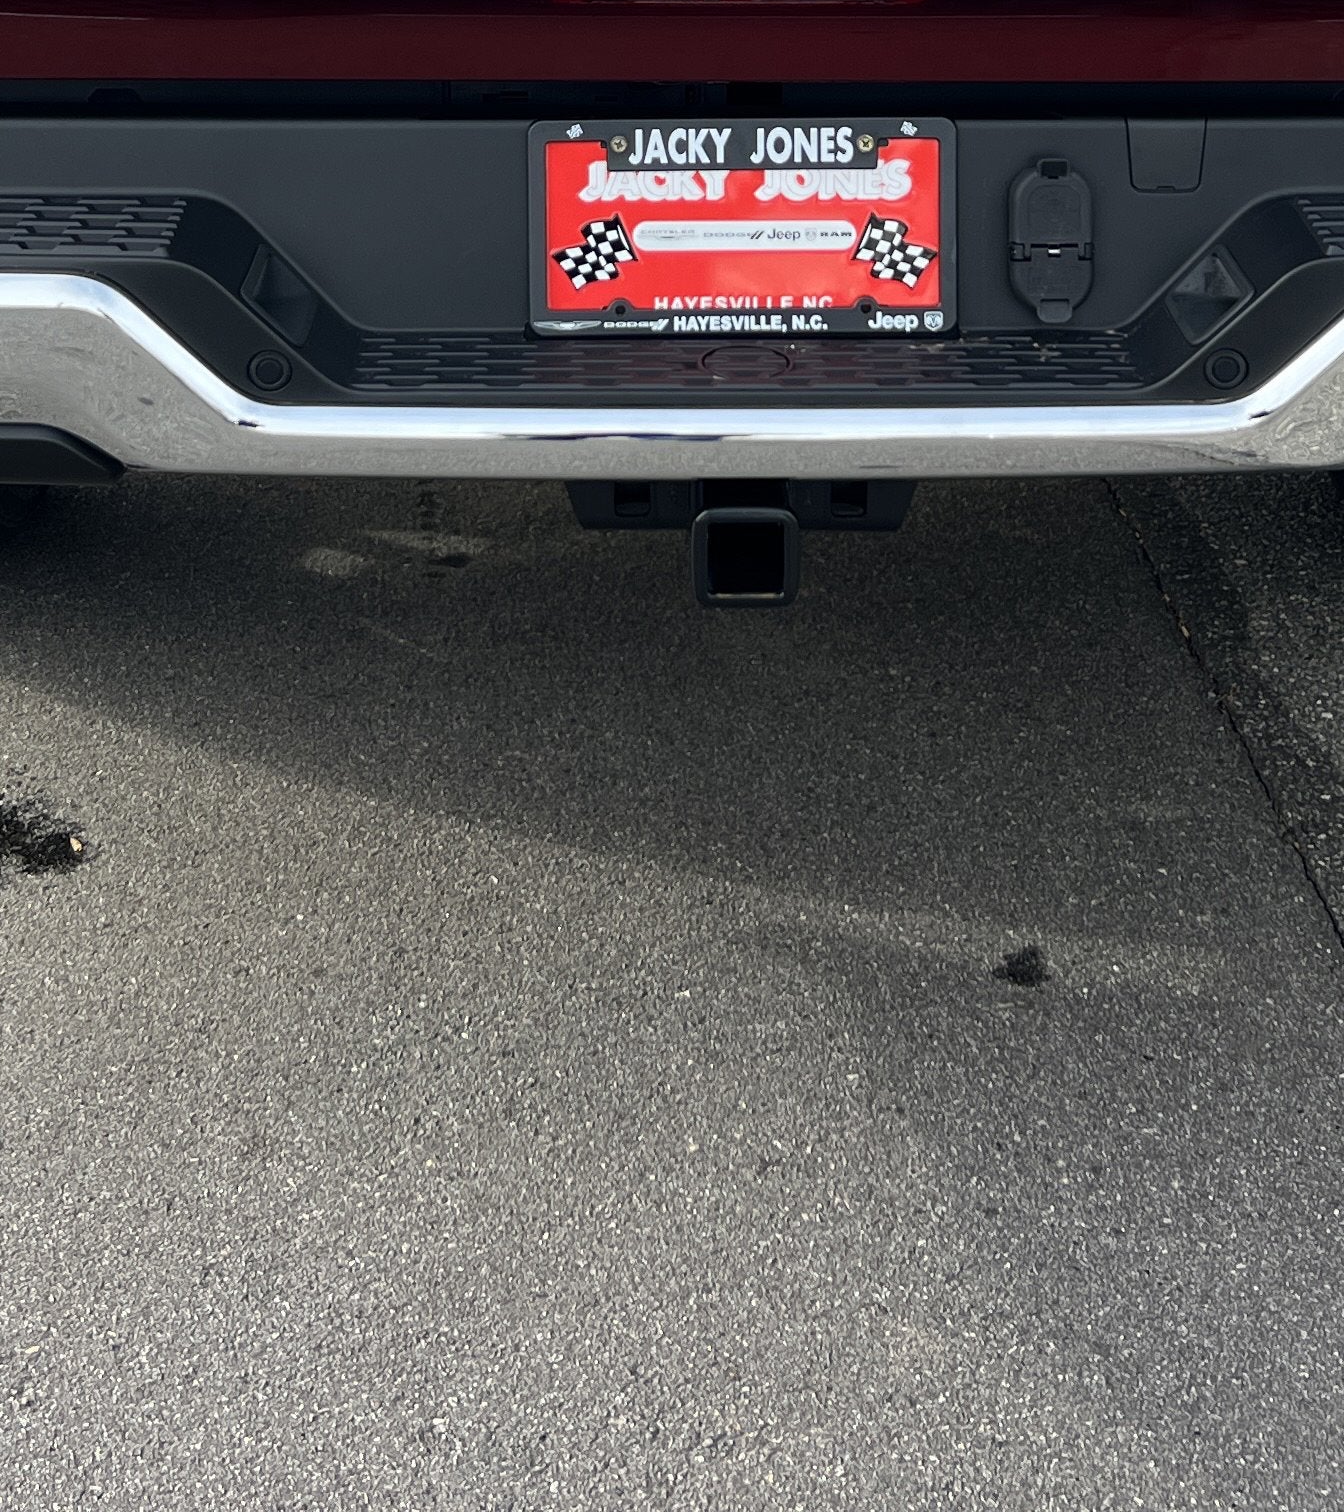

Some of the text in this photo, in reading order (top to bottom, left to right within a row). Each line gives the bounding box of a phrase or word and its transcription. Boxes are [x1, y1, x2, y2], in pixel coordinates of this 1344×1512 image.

[628, 126, 854, 165] JACKY JONES
[578, 158, 913, 202] JACKY JONES
[767, 228, 801, 241] Jeep
[803, 295, 833, 309] NC
[673, 314, 828, 334] HAYESVILLE, N.C.
[868, 312, 919, 332] Jeep
